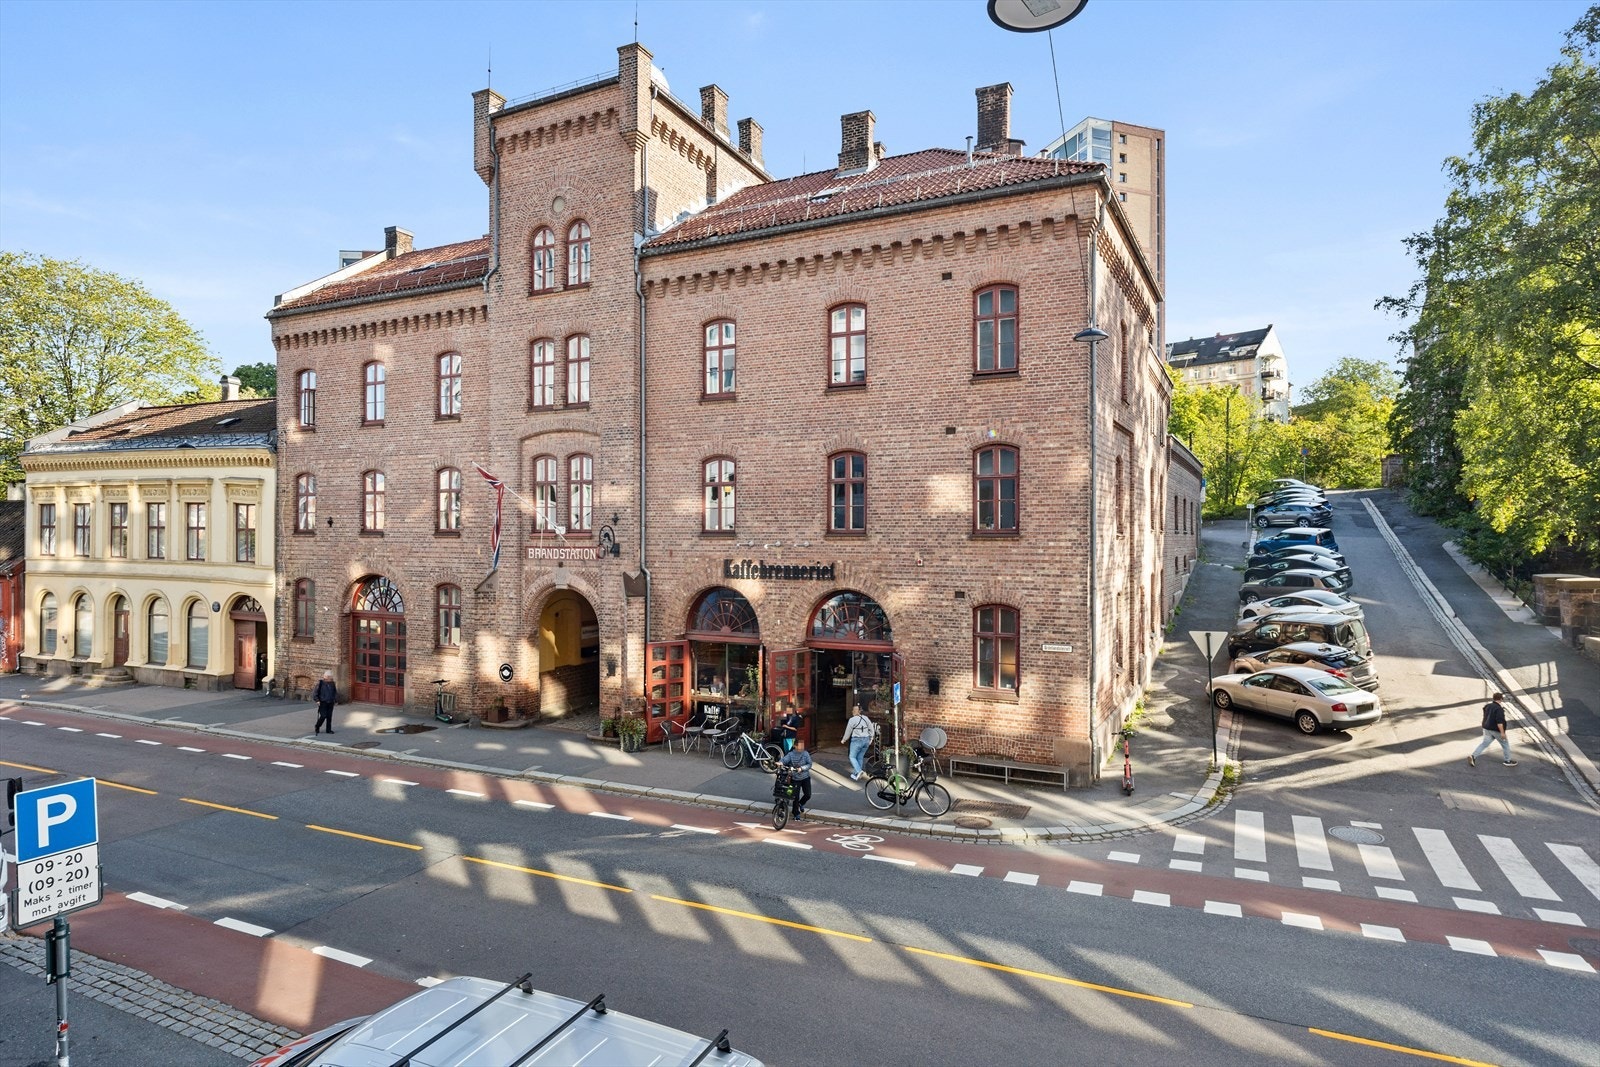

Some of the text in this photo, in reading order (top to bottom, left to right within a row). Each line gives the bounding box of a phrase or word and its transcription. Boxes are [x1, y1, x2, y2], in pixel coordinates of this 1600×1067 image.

[528, 547, 597, 560] BRANDSTATION
[723, 558, 836, 581] Kaffebrenneriet
[36, 793, 77, 849] P
[23, 880, 94, 908] Maks 2 timer
[31, 893, 87, 917] mot avgift
